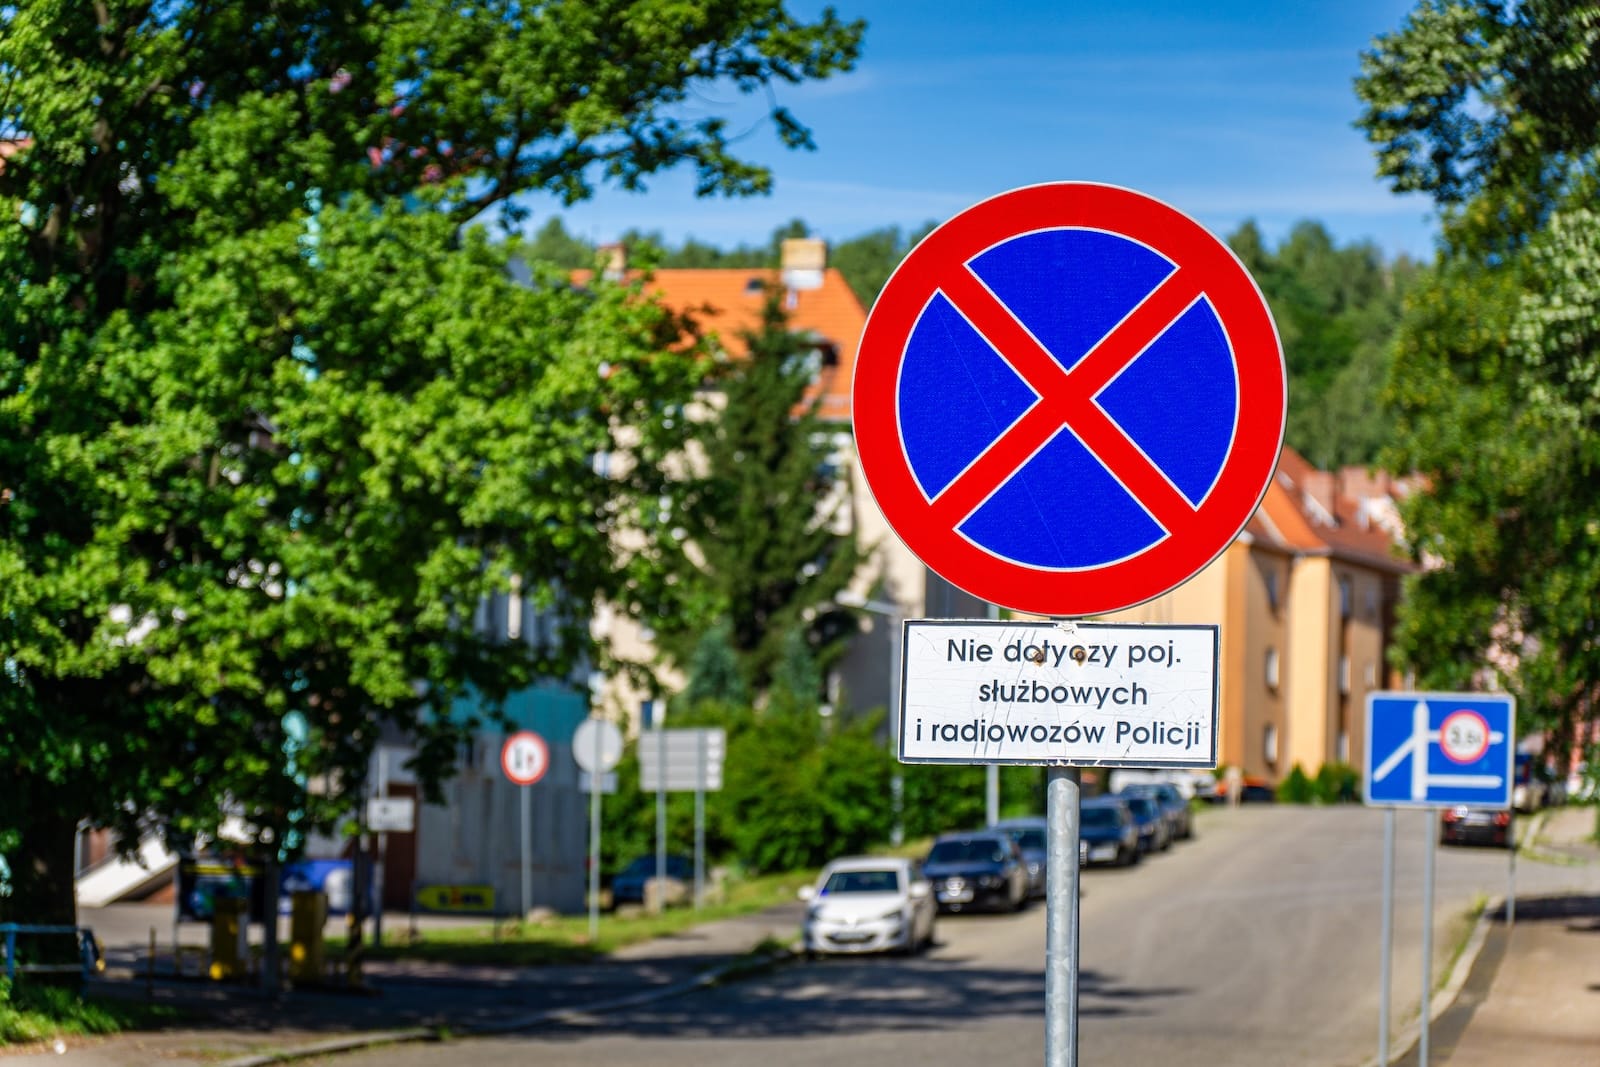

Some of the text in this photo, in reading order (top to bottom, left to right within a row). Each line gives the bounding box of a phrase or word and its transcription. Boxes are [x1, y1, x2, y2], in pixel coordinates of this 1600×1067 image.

[947, 638, 1181, 668] Nie dotyczy poj.
[978, 679, 1148, 709] służbowych
[915, 718, 1201, 749] i radiowozów Policji
